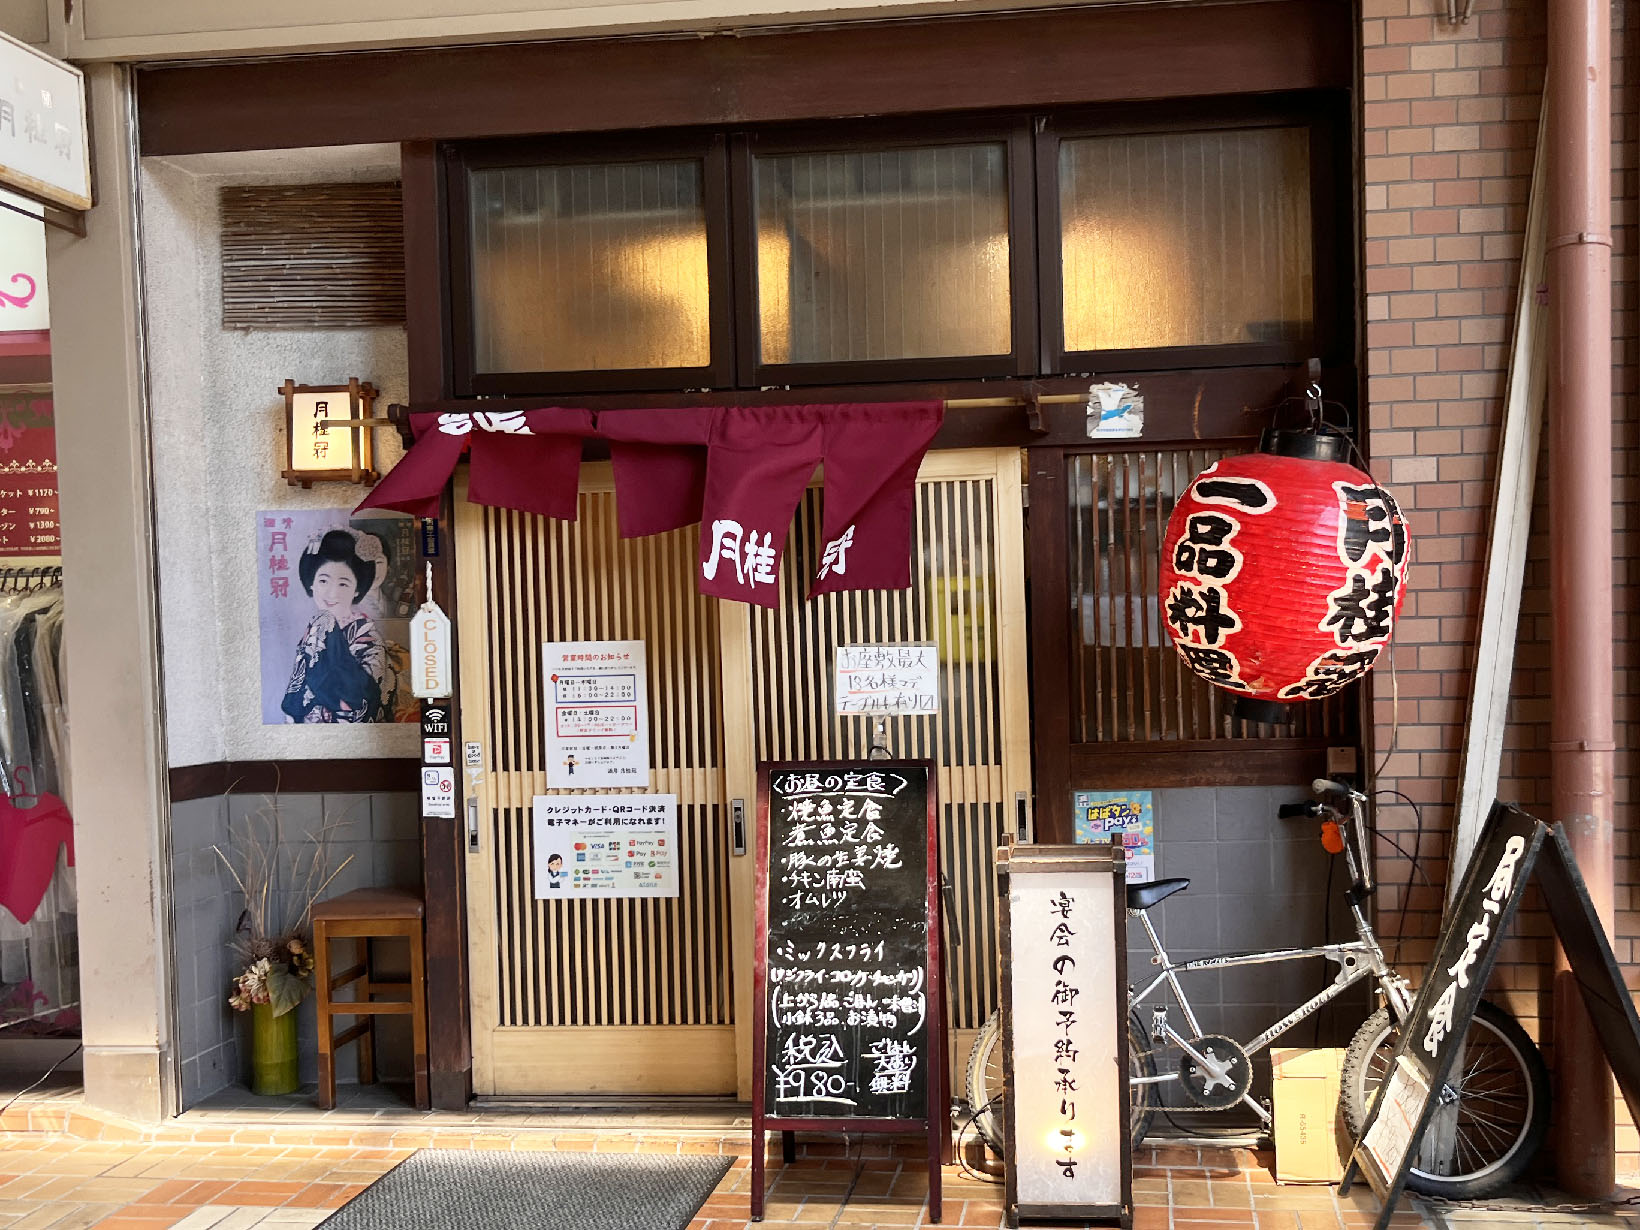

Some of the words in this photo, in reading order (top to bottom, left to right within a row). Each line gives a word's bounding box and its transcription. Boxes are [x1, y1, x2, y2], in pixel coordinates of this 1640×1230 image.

[423, 618, 440, 691] CLOSED
[561, 652, 630, 662] 営業時間のお知らせ
[781, 1032, 849, 1065] 税込
